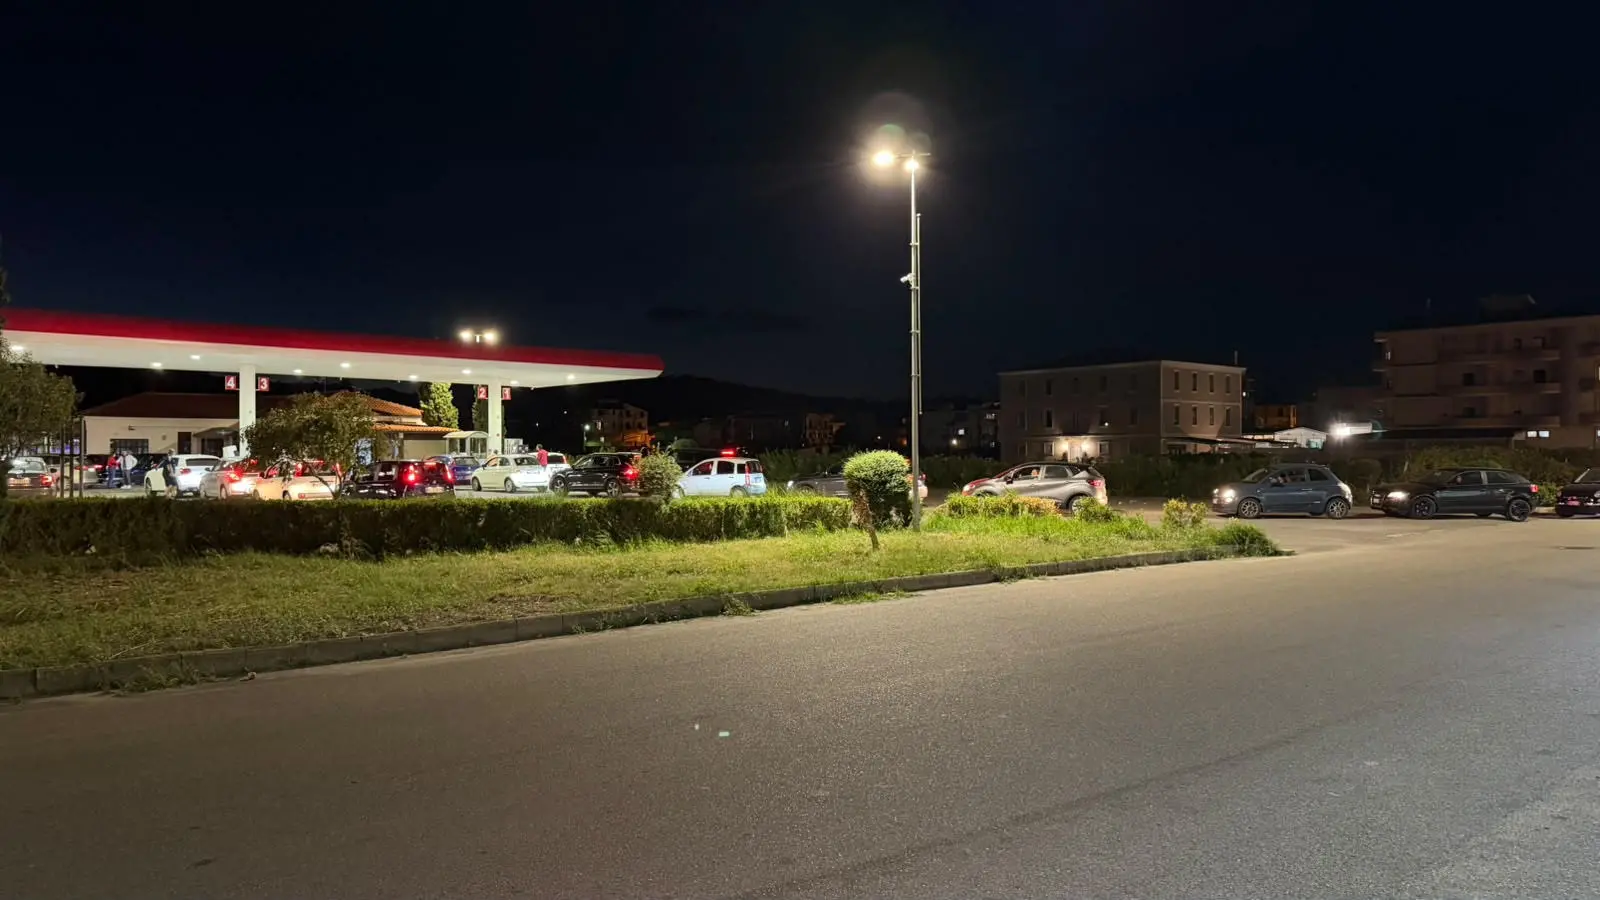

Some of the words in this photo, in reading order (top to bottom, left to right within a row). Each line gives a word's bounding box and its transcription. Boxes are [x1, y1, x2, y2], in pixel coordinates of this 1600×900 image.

[226, 376, 235, 389] 4
[260, 377, 268, 390] 3
[479, 386, 487, 399] 2
